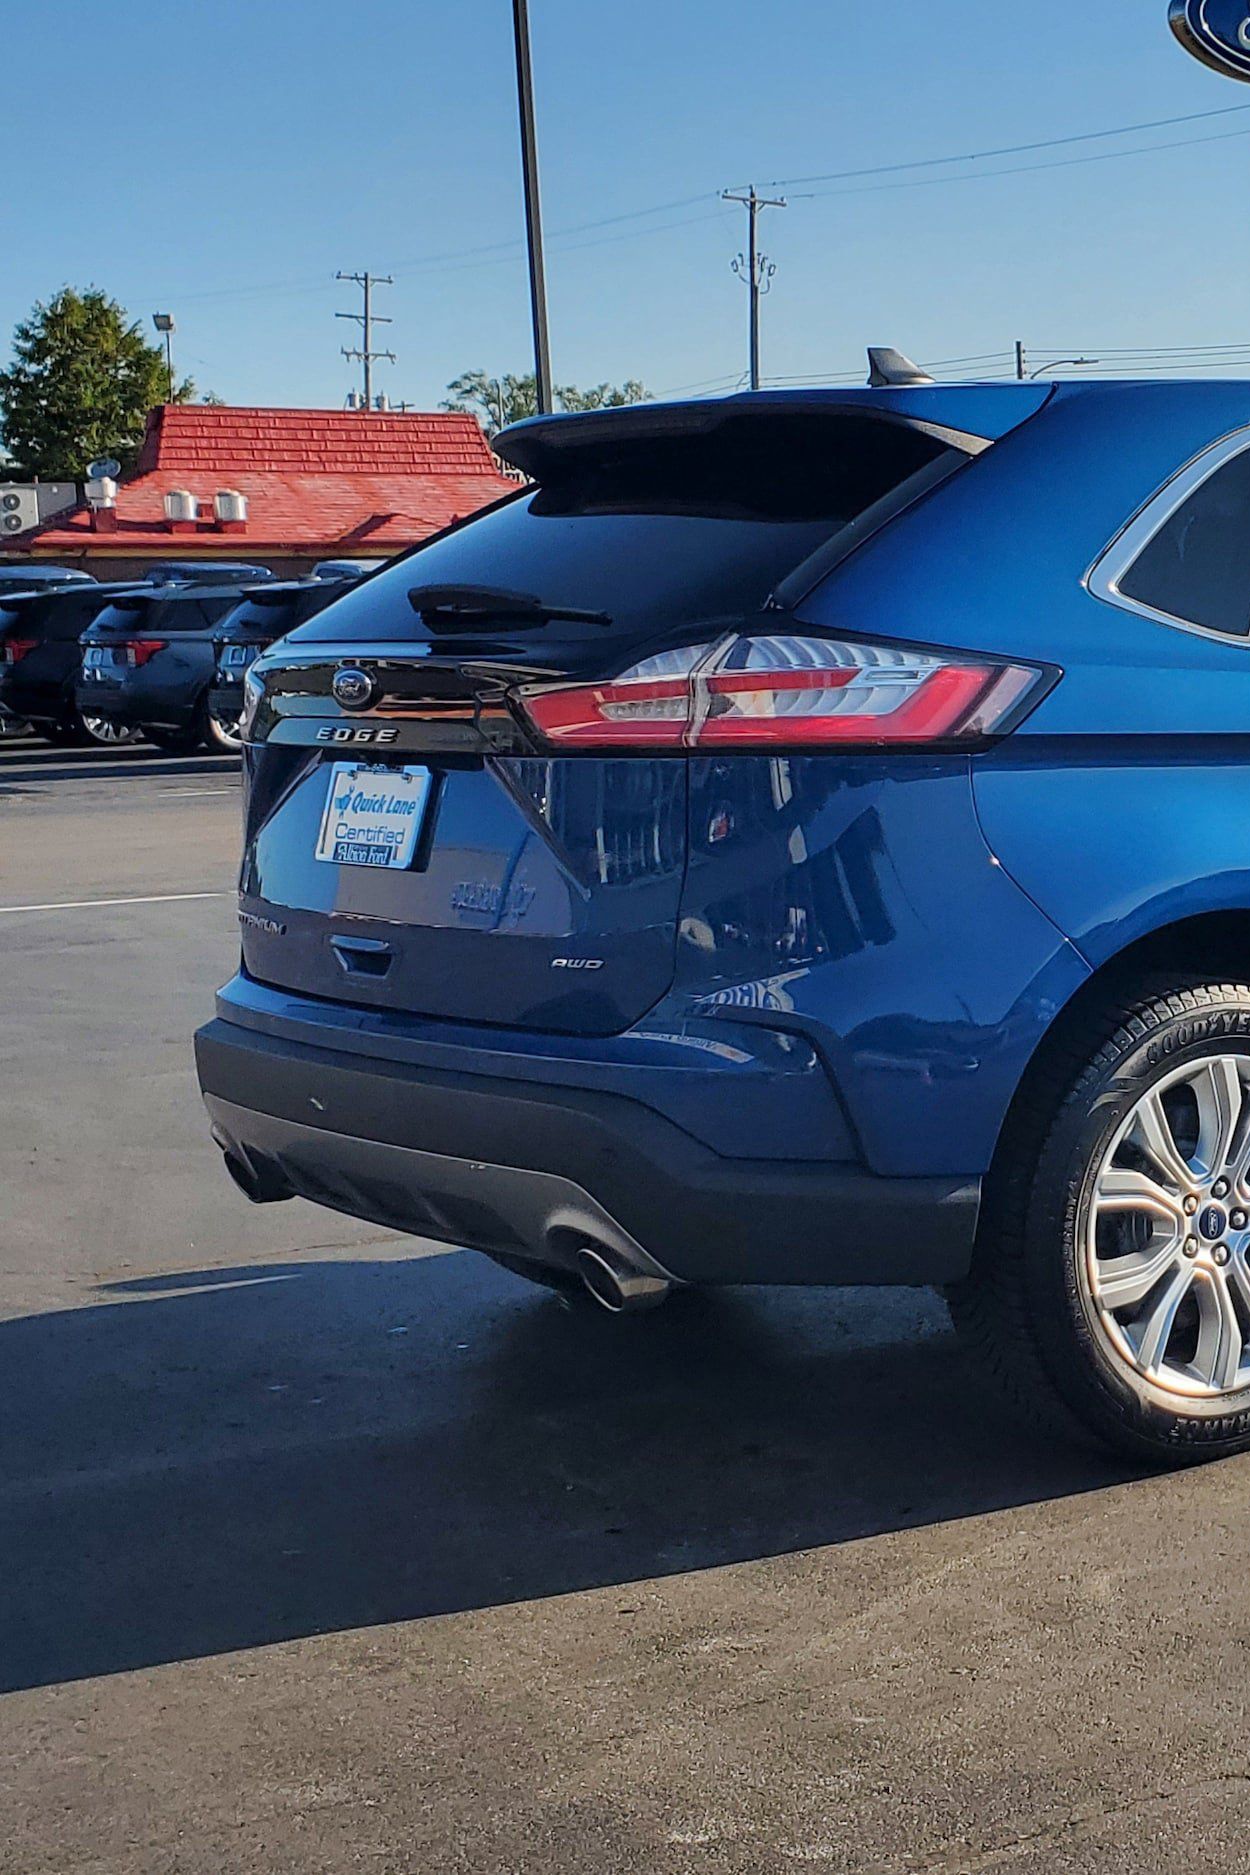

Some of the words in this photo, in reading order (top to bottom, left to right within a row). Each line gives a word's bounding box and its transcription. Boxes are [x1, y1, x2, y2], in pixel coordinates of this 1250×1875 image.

[316, 727, 397, 742] EDGE
[352, 791, 386, 814] Quick
[385, 795, 417, 815] Lane
[335, 822, 406, 845] Certified
[551, 958, 604, 969] AWD
